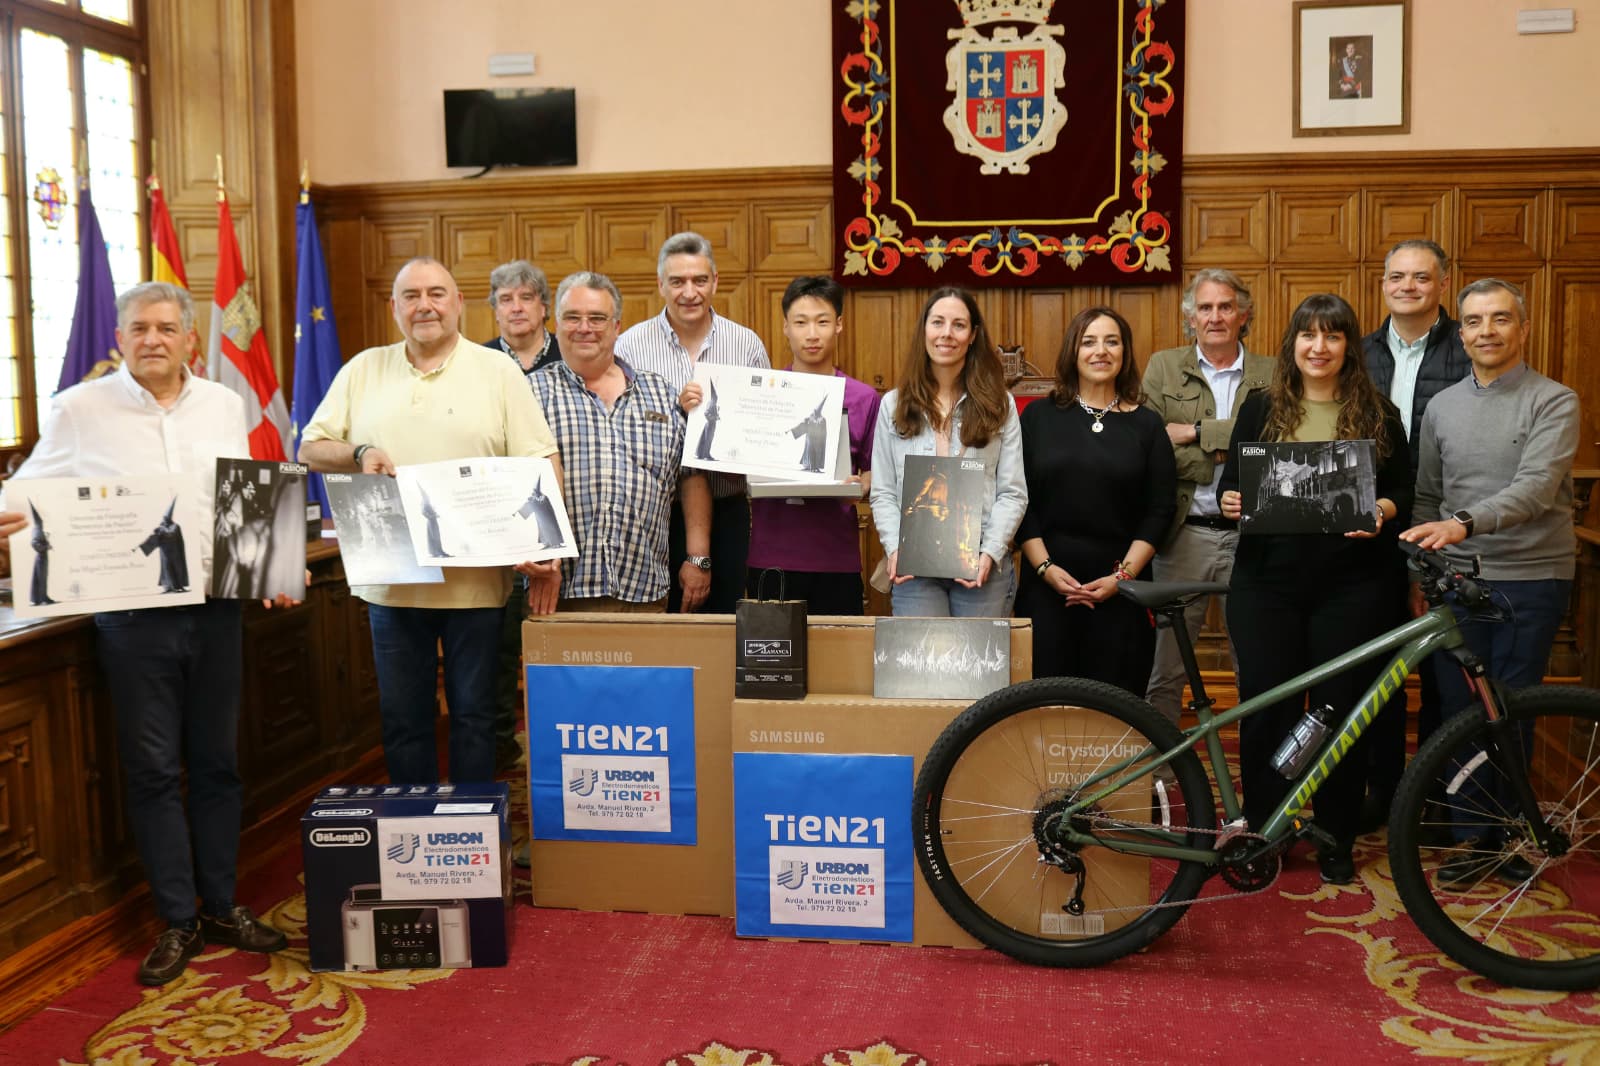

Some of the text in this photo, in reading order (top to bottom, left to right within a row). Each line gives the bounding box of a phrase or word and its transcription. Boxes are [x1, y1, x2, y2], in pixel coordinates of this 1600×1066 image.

[562, 650, 633, 663] SAMSUNG
[750, 730, 825, 744] SAMSUNG
[1049, 743, 1145, 761] Crystal UHD
[604, 769, 654, 782] URBON
[427, 832, 483, 845] URBON
[816, 862, 869, 875] URBON
